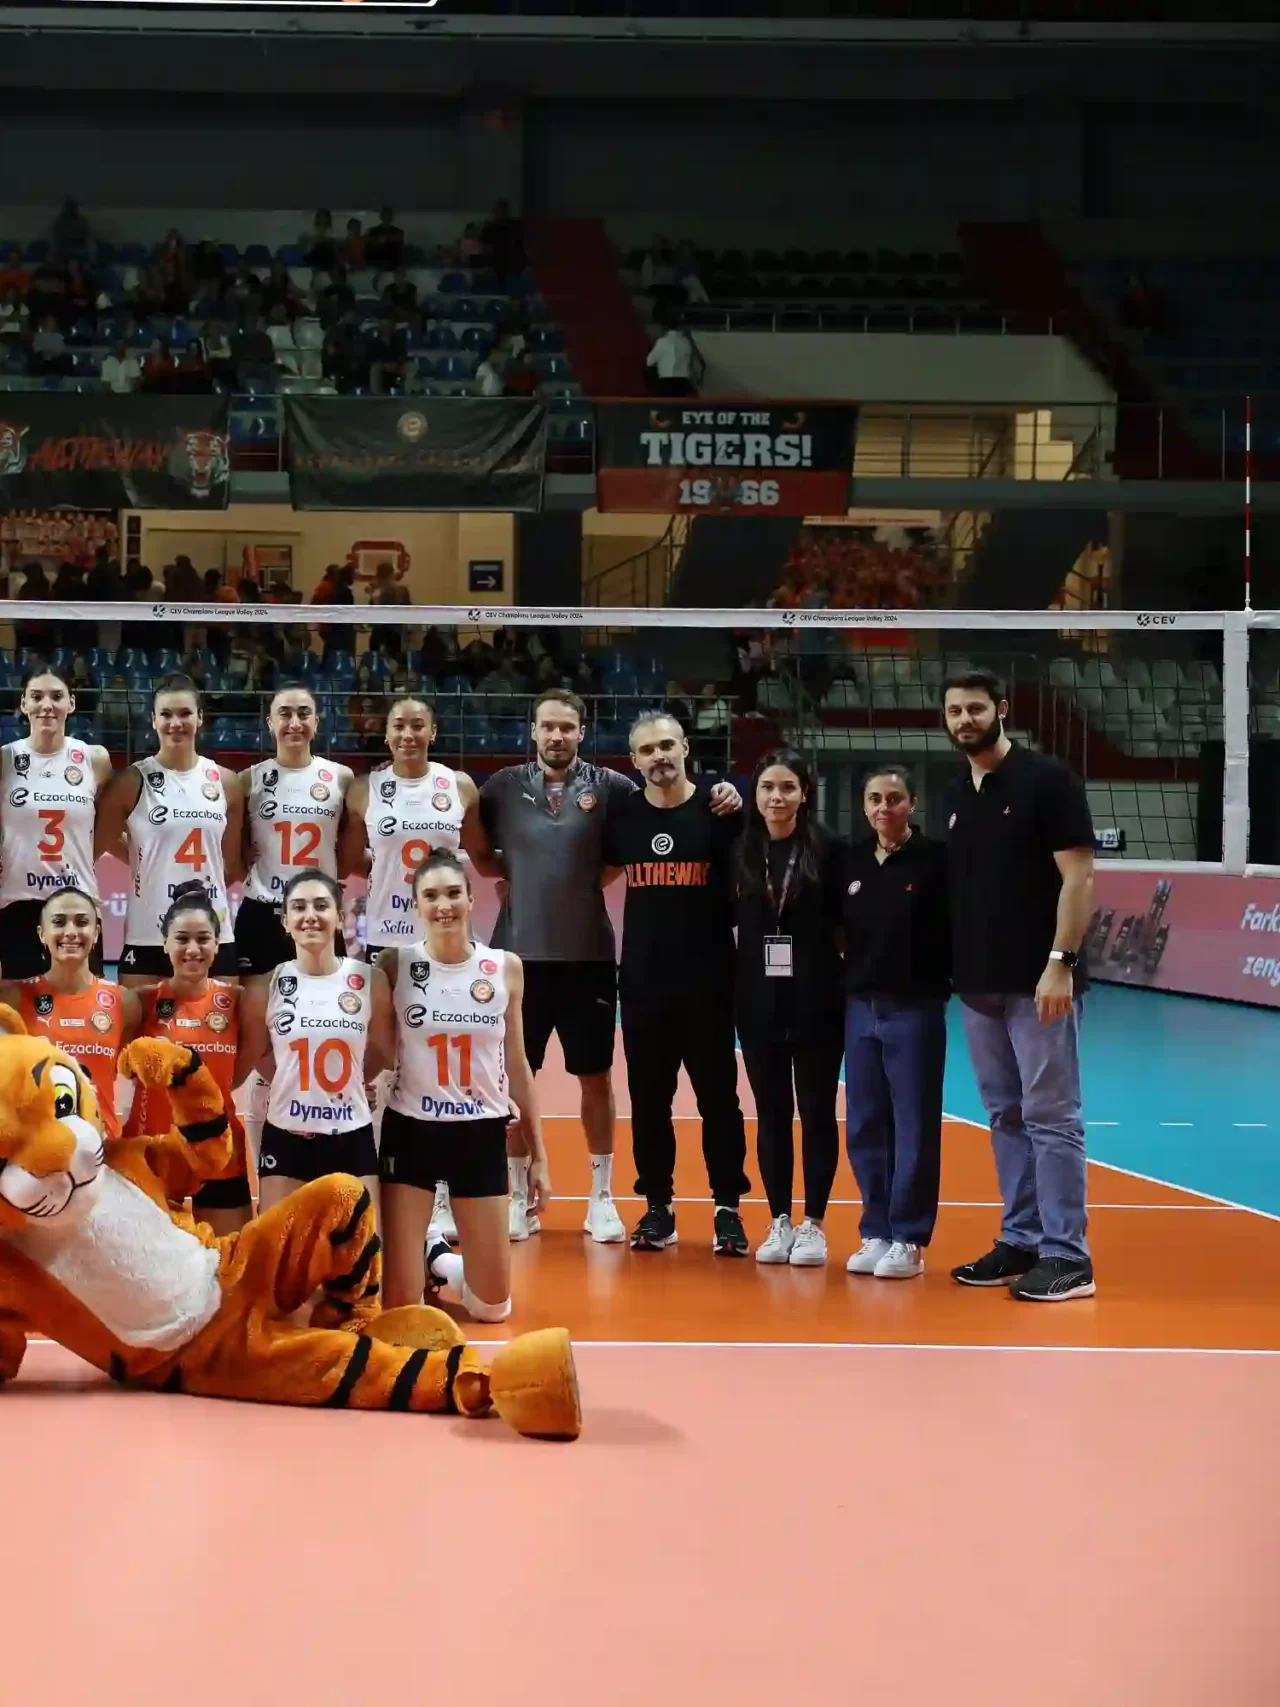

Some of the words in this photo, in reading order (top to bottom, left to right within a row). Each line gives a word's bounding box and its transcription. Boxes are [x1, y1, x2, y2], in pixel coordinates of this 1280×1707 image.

[682, 410, 713, 425] EYE
[717, 411, 737, 425] OF
[739, 411, 771, 426] THE
[640, 432, 813, 467] TIGERS!
[183, 608, 214, 616] Champions
[498, 612, 529, 620] Champions
[530, 612, 551, 620] League
[1152, 616, 1176, 624] CEV
[37, 809, 66, 854] 3
[174, 827, 207, 872] 4
[274, 821, 321, 866] 12
[401, 839, 432, 885] 9
[27, 872, 79, 890] Dynavit
[381, 919, 414, 935] Selin
[124, 950, 136, 965] 4
[55, 1041, 115, 1057] Eczacıbaş
[428, 1033, 472, 1087] 11
[289, 1038, 352, 1093] 10
[290, 1100, 353, 1122] Dynavit
[421, 1096, 484, 1118] Dynavit
